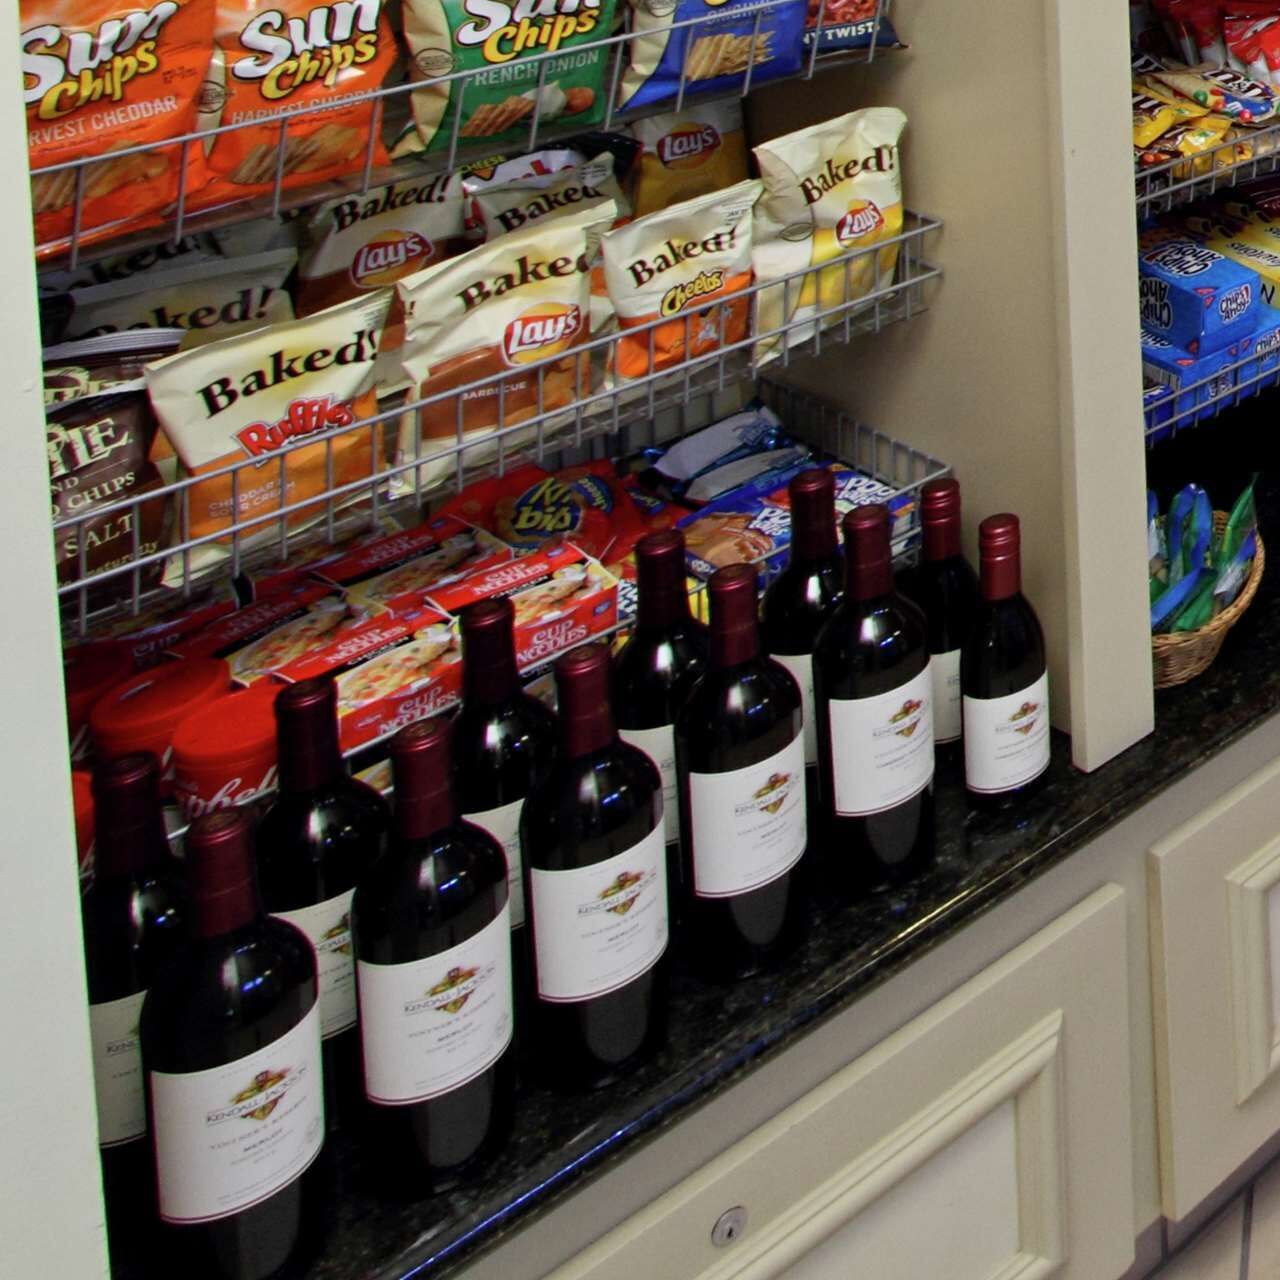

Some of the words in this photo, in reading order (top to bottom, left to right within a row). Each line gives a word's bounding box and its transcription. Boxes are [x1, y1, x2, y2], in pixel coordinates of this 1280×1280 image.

[19, 0, 181, 105] Sun
[482, 7, 600, 65] Chips
[38, 39, 160, 120] Chips
[261, 33, 378, 101] Chips
[91, 94, 179, 131] CHEDDAR
[661, 124, 722, 162] Lay's
[798, 143, 898, 207] Baked!
[331, 173, 448, 234] Baked!
[837, 200, 883, 242] Lay's
[354, 234, 425, 279] Lay's
[626, 224, 738, 290] Baked!
[660, 268, 725, 317] Cheetos
[508, 307, 581, 354] Lay's
[197, 326, 379, 420] Baked!
[461, 381, 528, 401] BARBCUE
[234, 393, 356, 464] Ruffles
[66, 470, 137, 510] CHIPS
[63, 513, 134, 560] SALT
[516, 624, 589, 664] NOODLES
[533, 619, 575, 644] CUP
[400, 686, 442, 716] CUP
